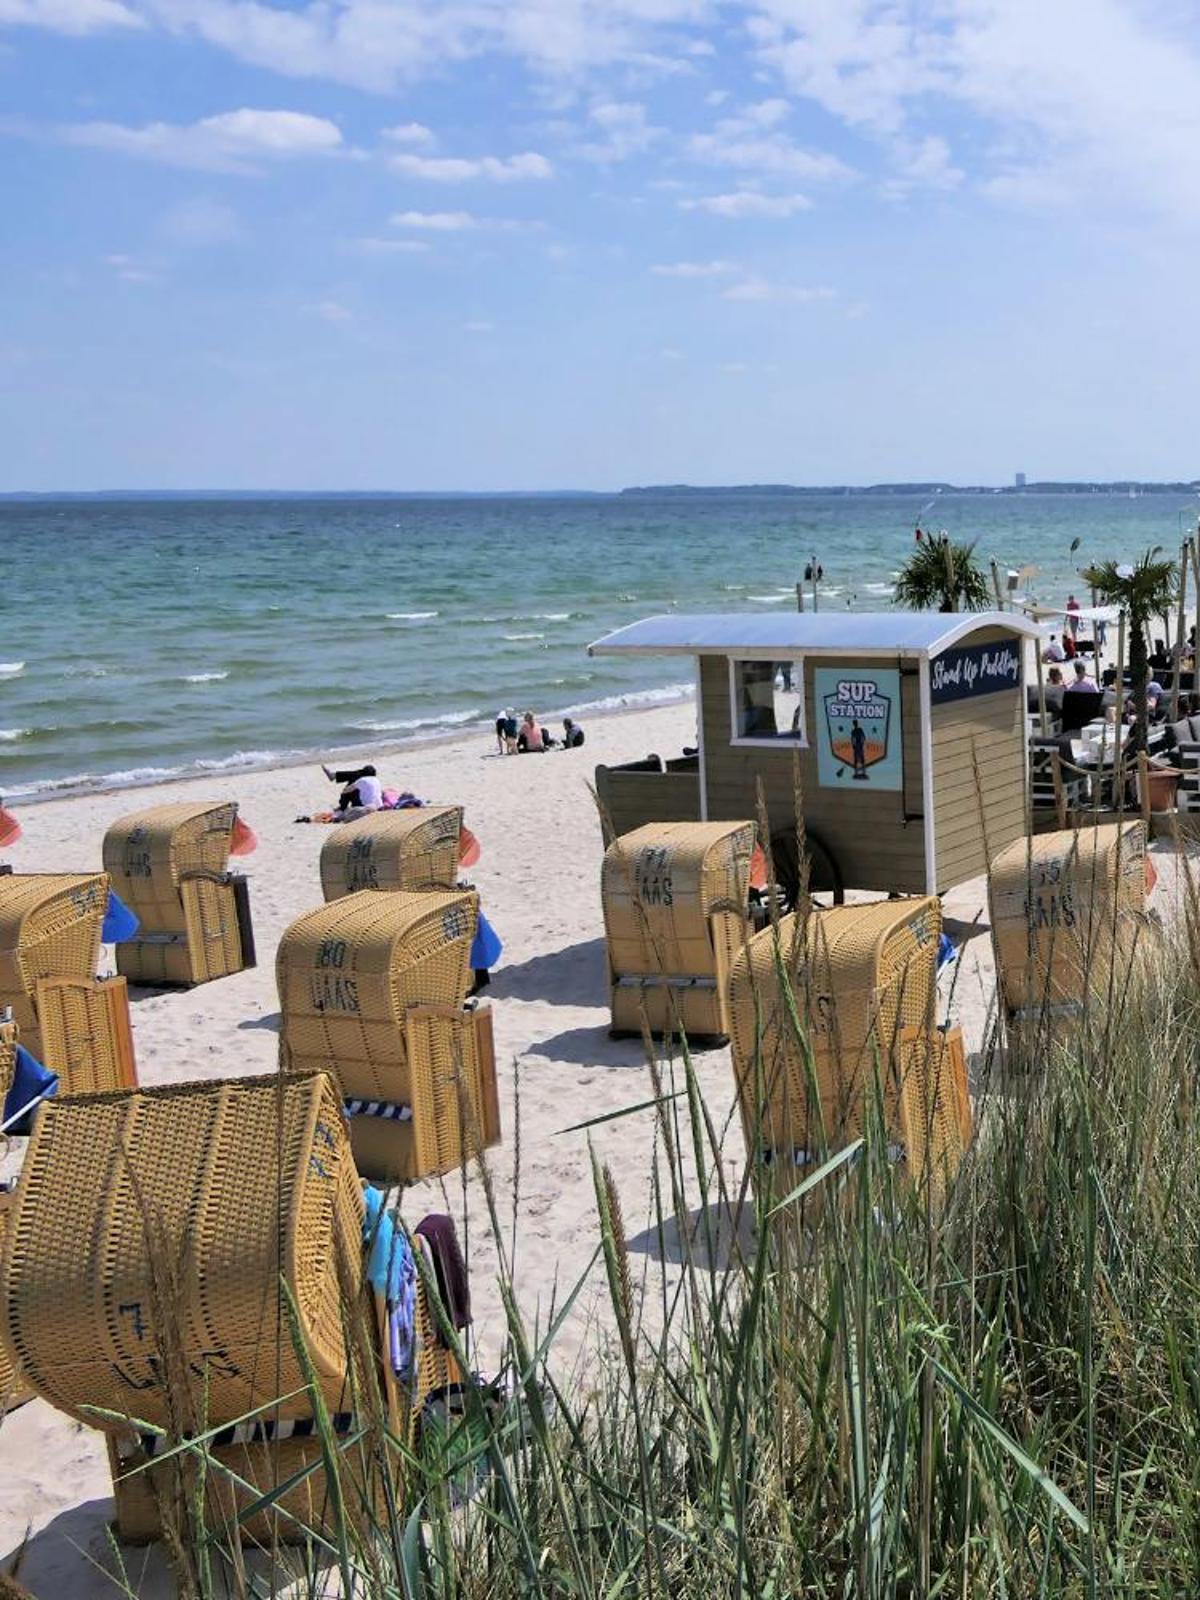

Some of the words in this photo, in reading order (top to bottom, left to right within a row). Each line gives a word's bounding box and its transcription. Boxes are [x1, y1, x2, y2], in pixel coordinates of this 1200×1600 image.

[932, 658, 961, 690] Stand
[963, 657, 978, 689] Up
[980, 648, 1018, 680] Paddling
[838, 682, 876, 701] SUP
[831, 704, 884, 718] STATION
